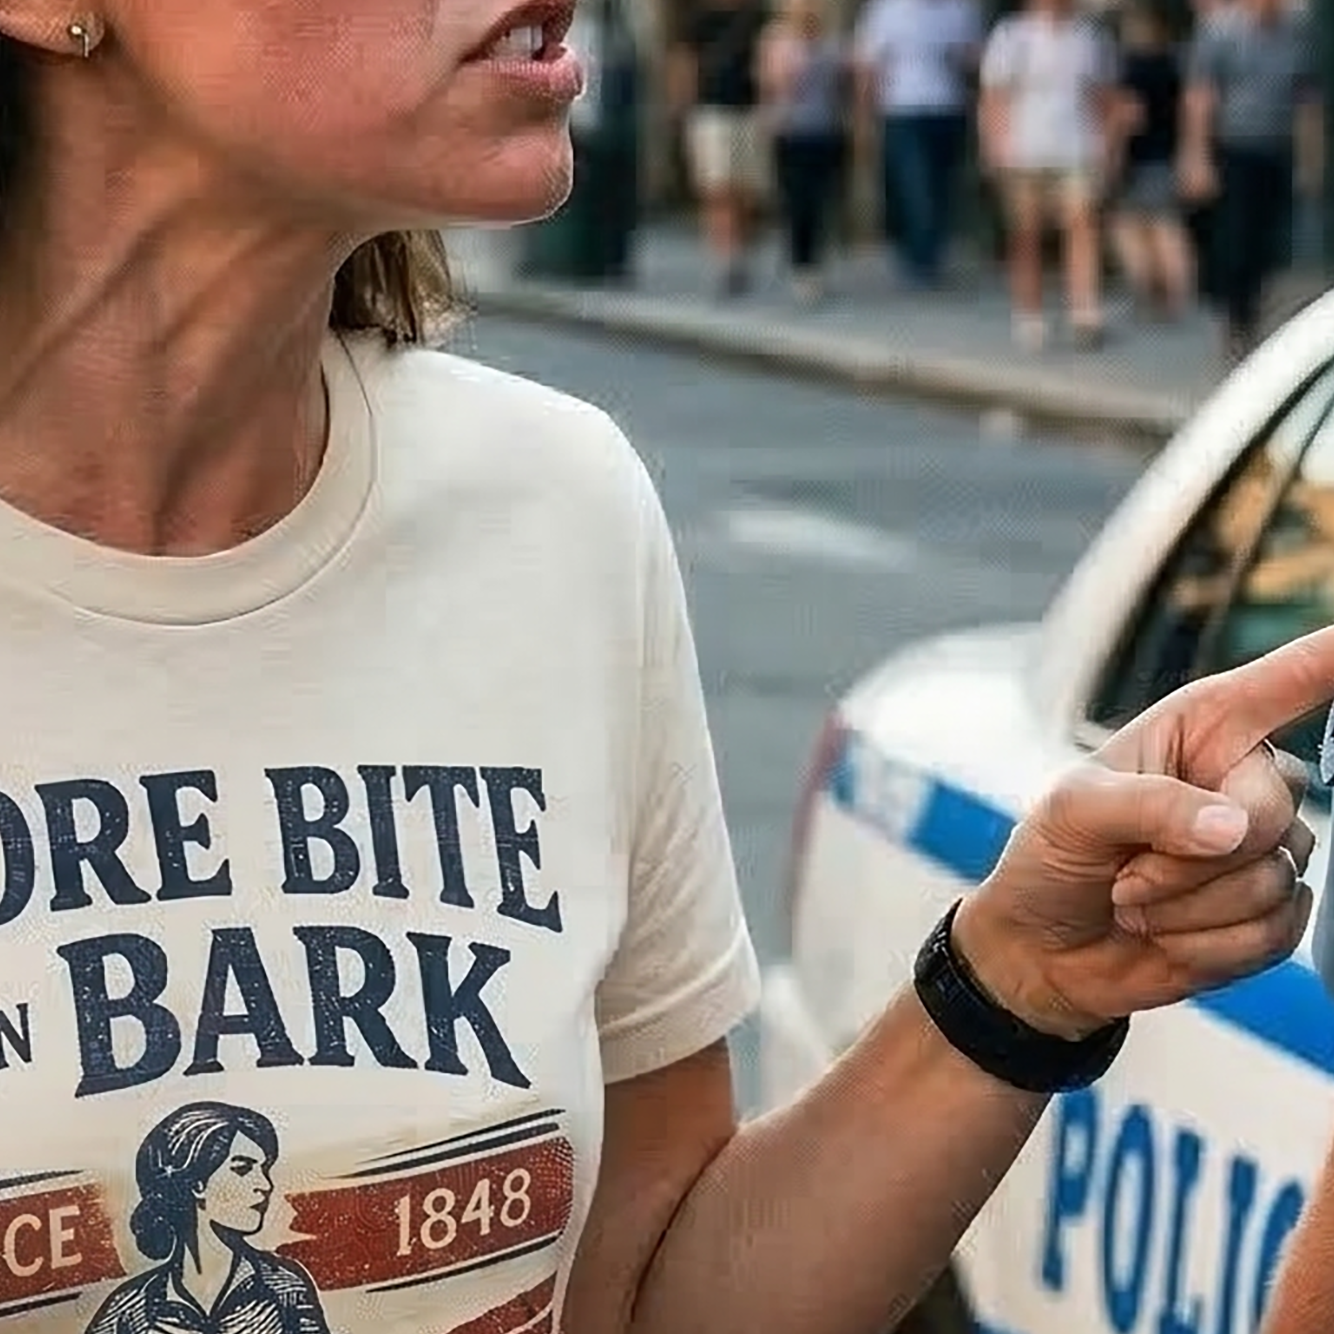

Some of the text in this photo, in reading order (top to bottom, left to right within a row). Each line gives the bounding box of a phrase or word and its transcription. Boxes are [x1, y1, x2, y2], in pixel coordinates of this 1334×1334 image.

[264, 764, 563, 933] BITE
[57, 925, 532, 1099] BARK
[395, 1167, 531, 1257] 1848
